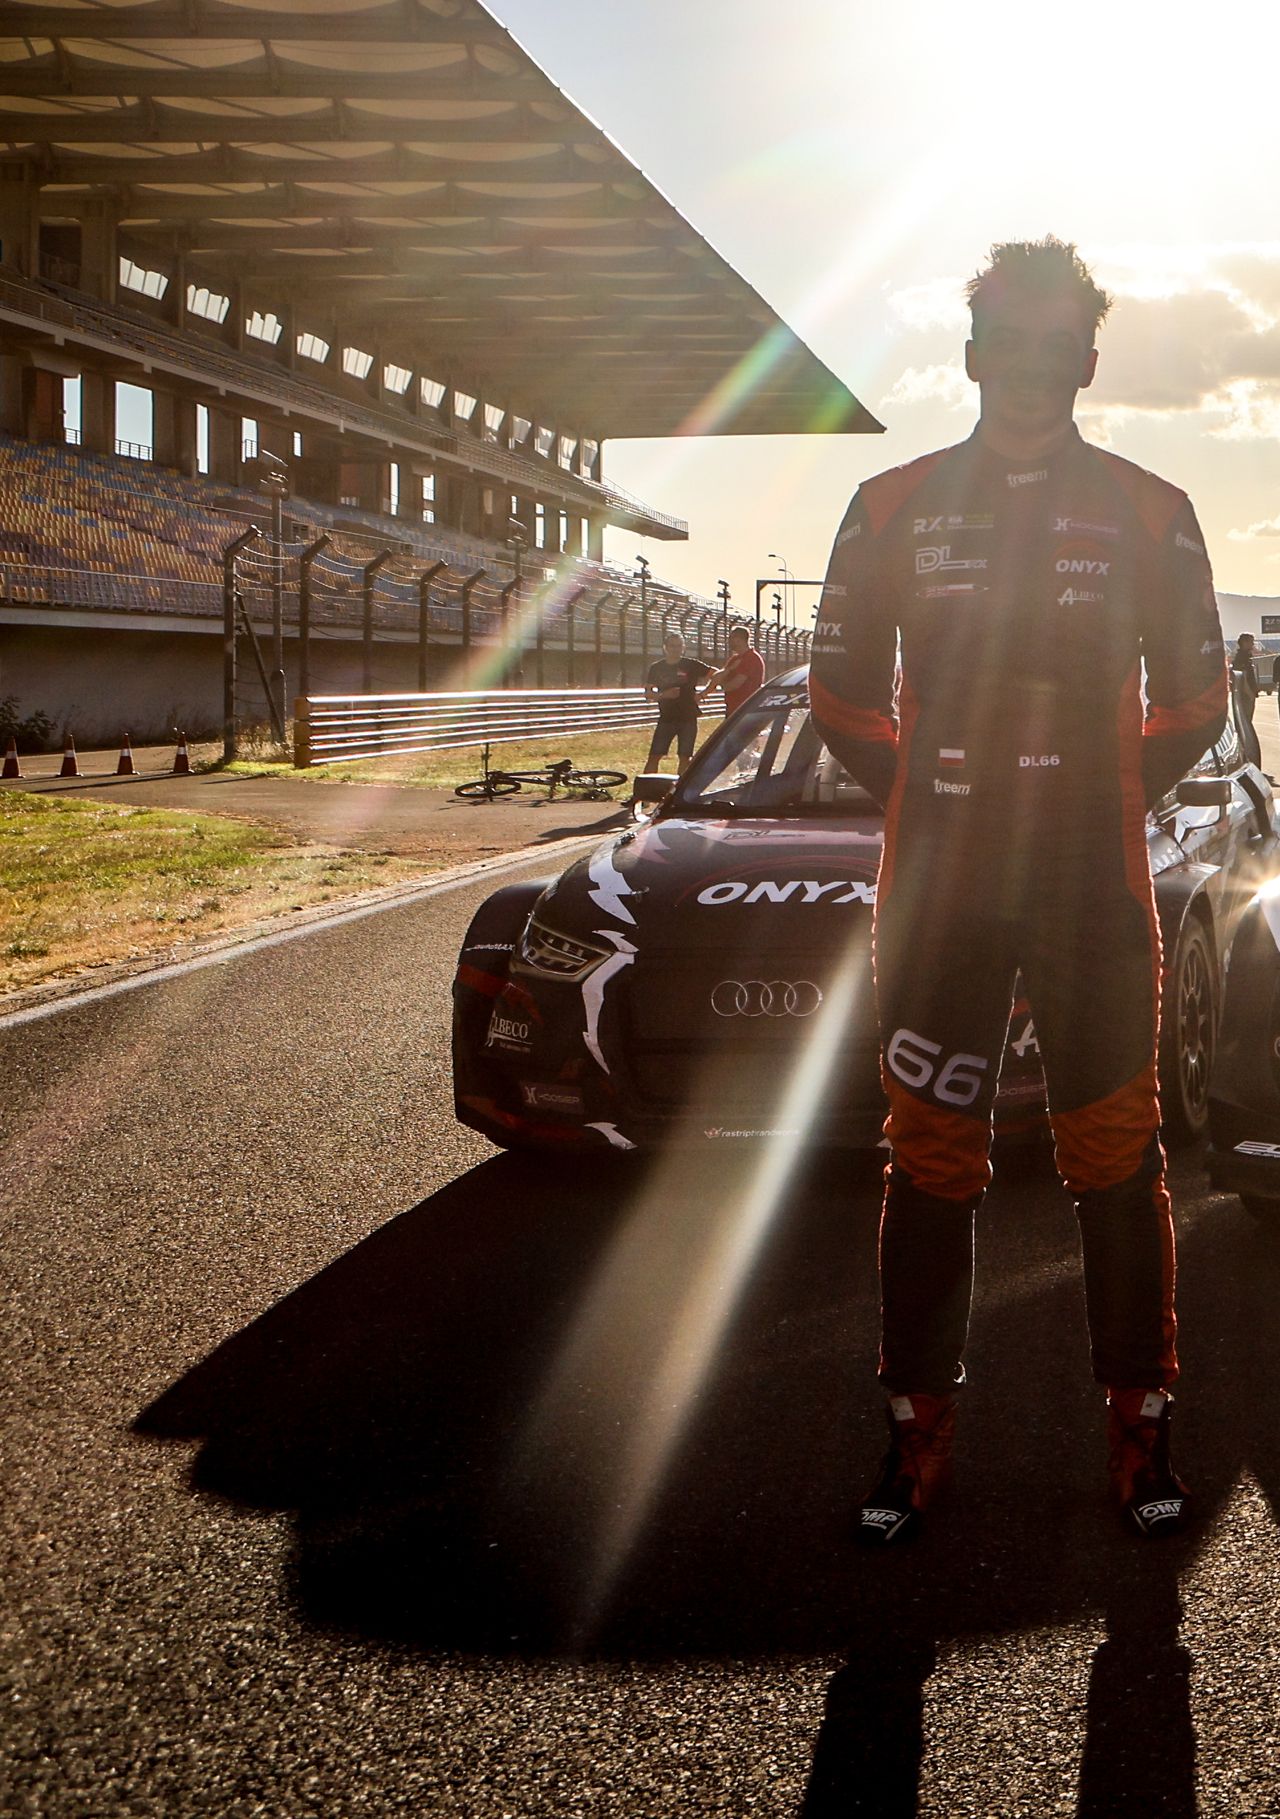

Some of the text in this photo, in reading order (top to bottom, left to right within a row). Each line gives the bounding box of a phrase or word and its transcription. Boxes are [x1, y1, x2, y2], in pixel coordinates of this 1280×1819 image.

[1007, 469, 1048, 488] freem
[1056, 560, 1110, 575] ONYX
[1018, 754, 1060, 767] DL66
[934, 778, 971, 796] freem
[697, 881, 878, 905] ONYX
[887, 1028, 988, 1104] 66
[1142, 1502, 1182, 1518] OMP
